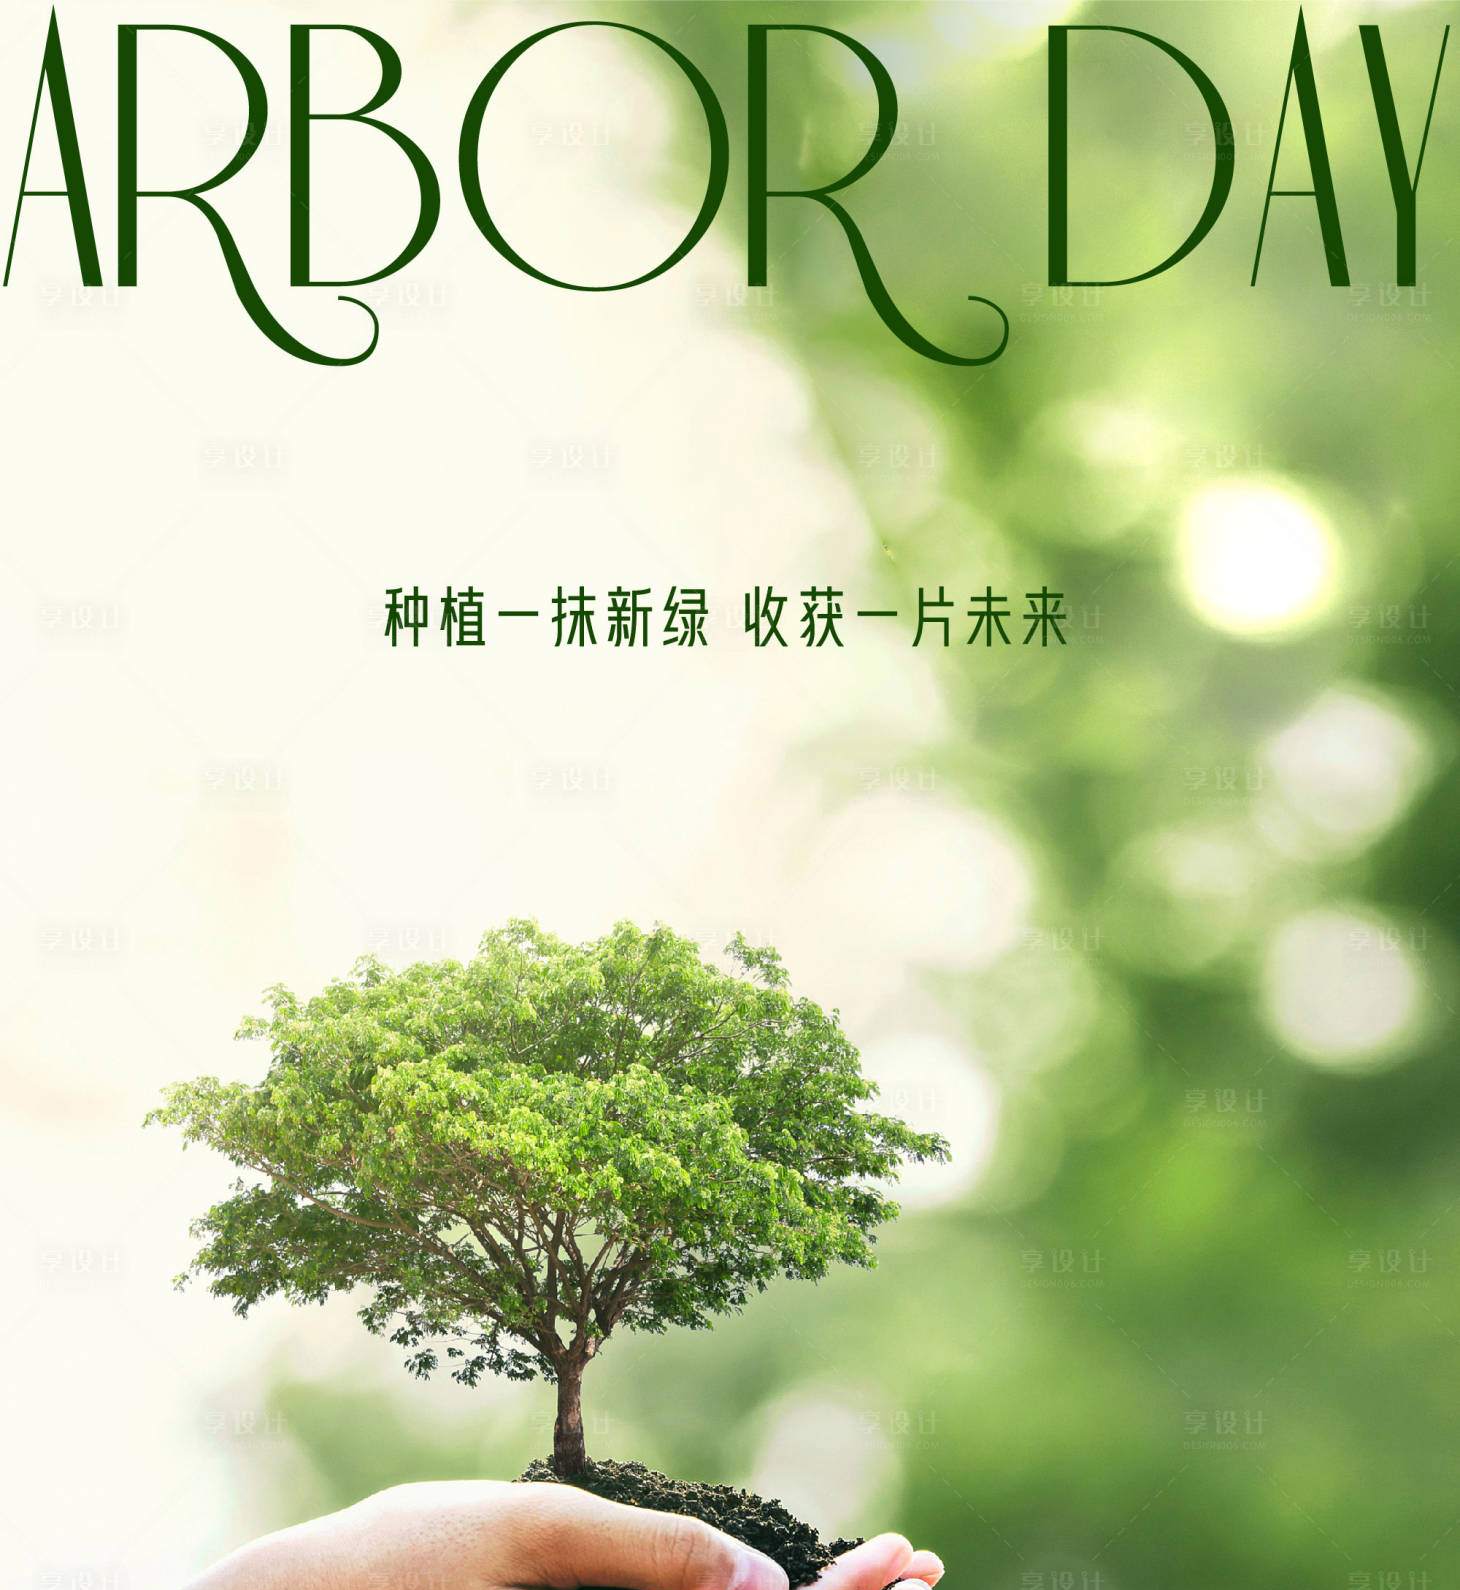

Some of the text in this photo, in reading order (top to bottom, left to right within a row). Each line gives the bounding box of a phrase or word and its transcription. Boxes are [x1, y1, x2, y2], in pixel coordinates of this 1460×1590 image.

[3, 4, 1450, 367] ARBOR DAY
[385, 586, 1067, 647] 种植一抹新绿 收获一片未来
